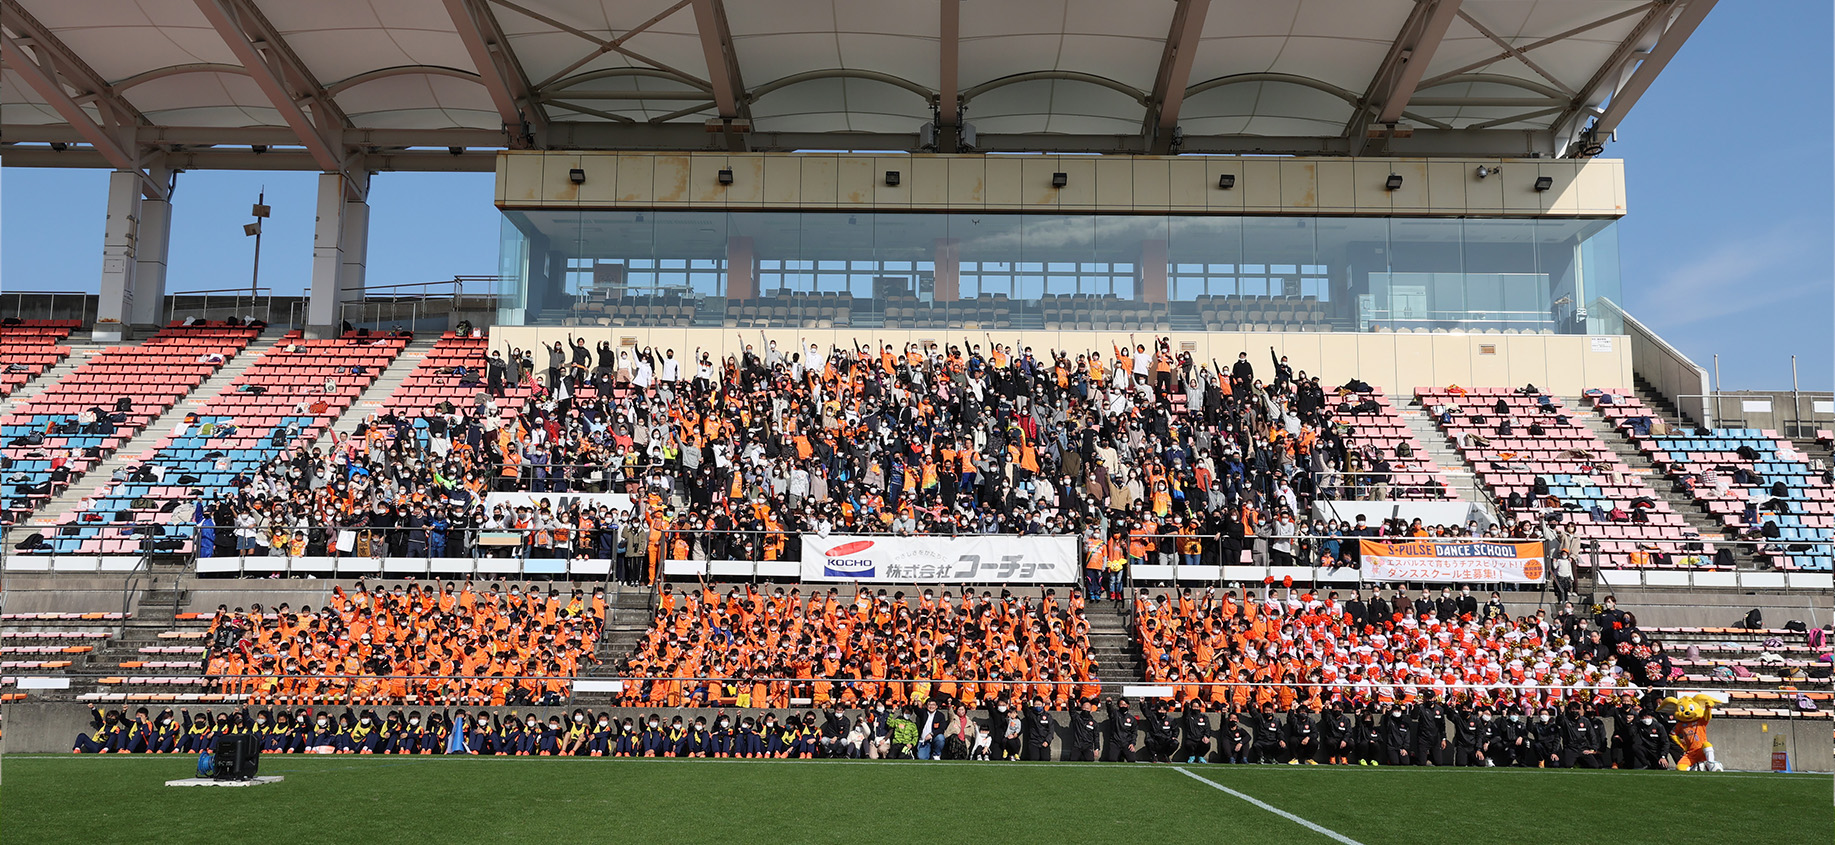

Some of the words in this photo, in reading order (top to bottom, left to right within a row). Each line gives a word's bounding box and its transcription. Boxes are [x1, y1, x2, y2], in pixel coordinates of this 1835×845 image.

[1436, 545, 1471, 556] DANCE
[1473, 544, 1515, 557] SCHOOL
[827, 559, 872, 567] KOCHO
